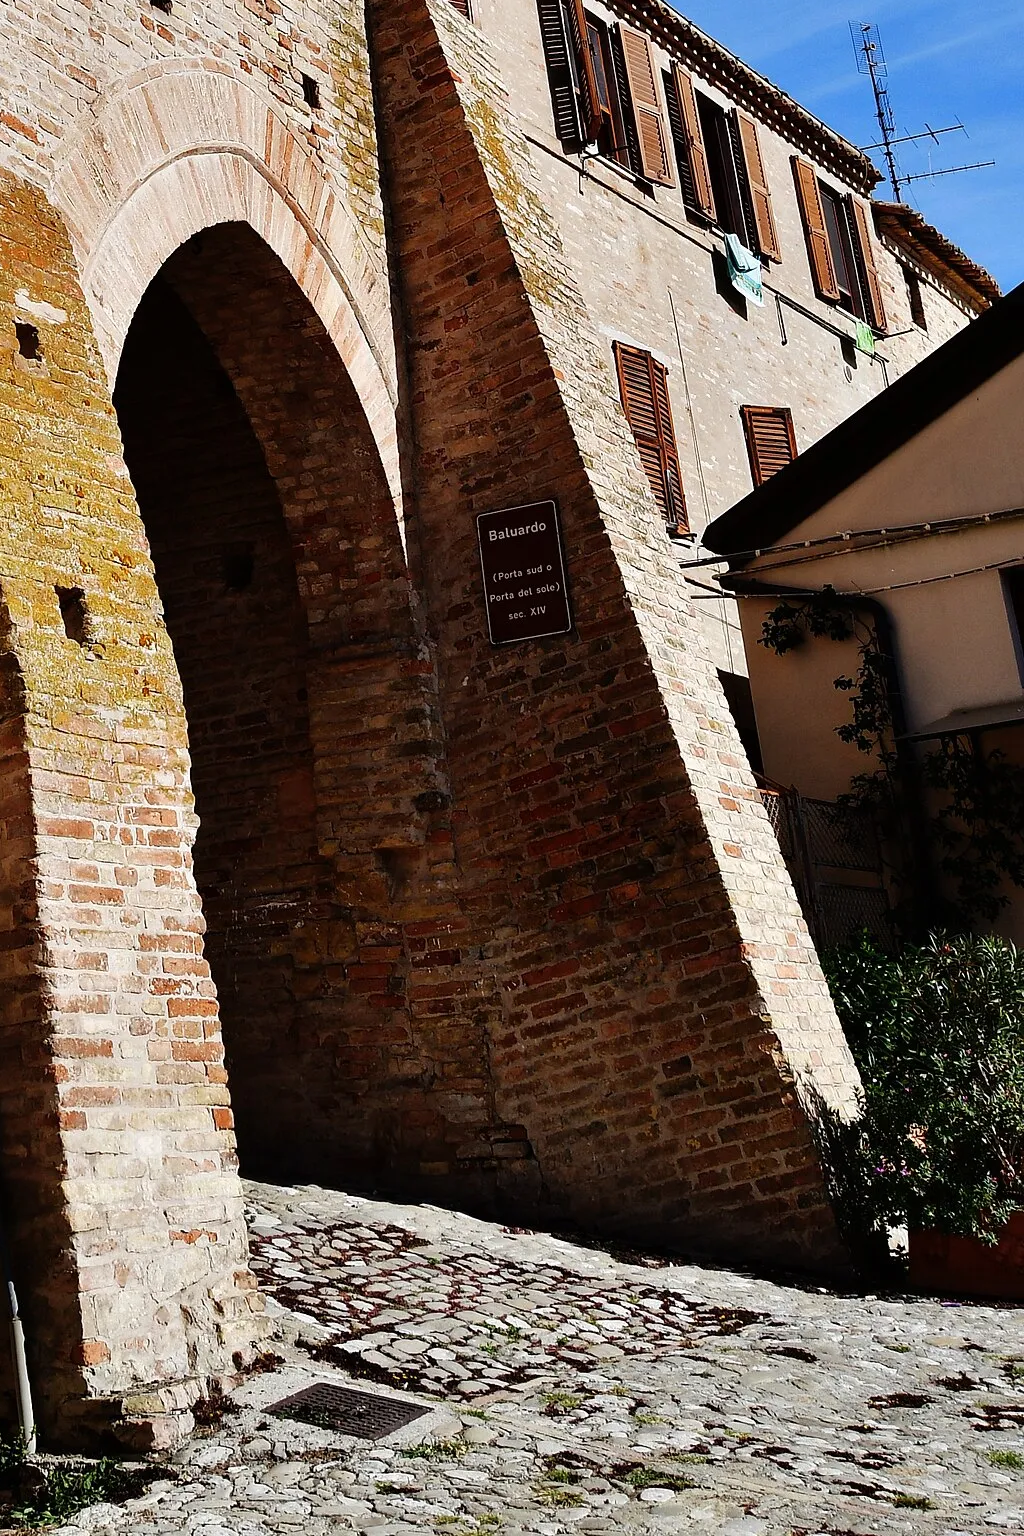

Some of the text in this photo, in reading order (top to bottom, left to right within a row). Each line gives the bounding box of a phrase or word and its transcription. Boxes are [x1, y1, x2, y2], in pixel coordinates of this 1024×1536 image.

[489, 521, 547, 542] Baluardo
[492, 569, 523, 582] (Porta
[526, 564, 543, 575] sud
[490, 582, 560, 602] Porta del sole)
[508, 605, 547, 620] sec. XIV
